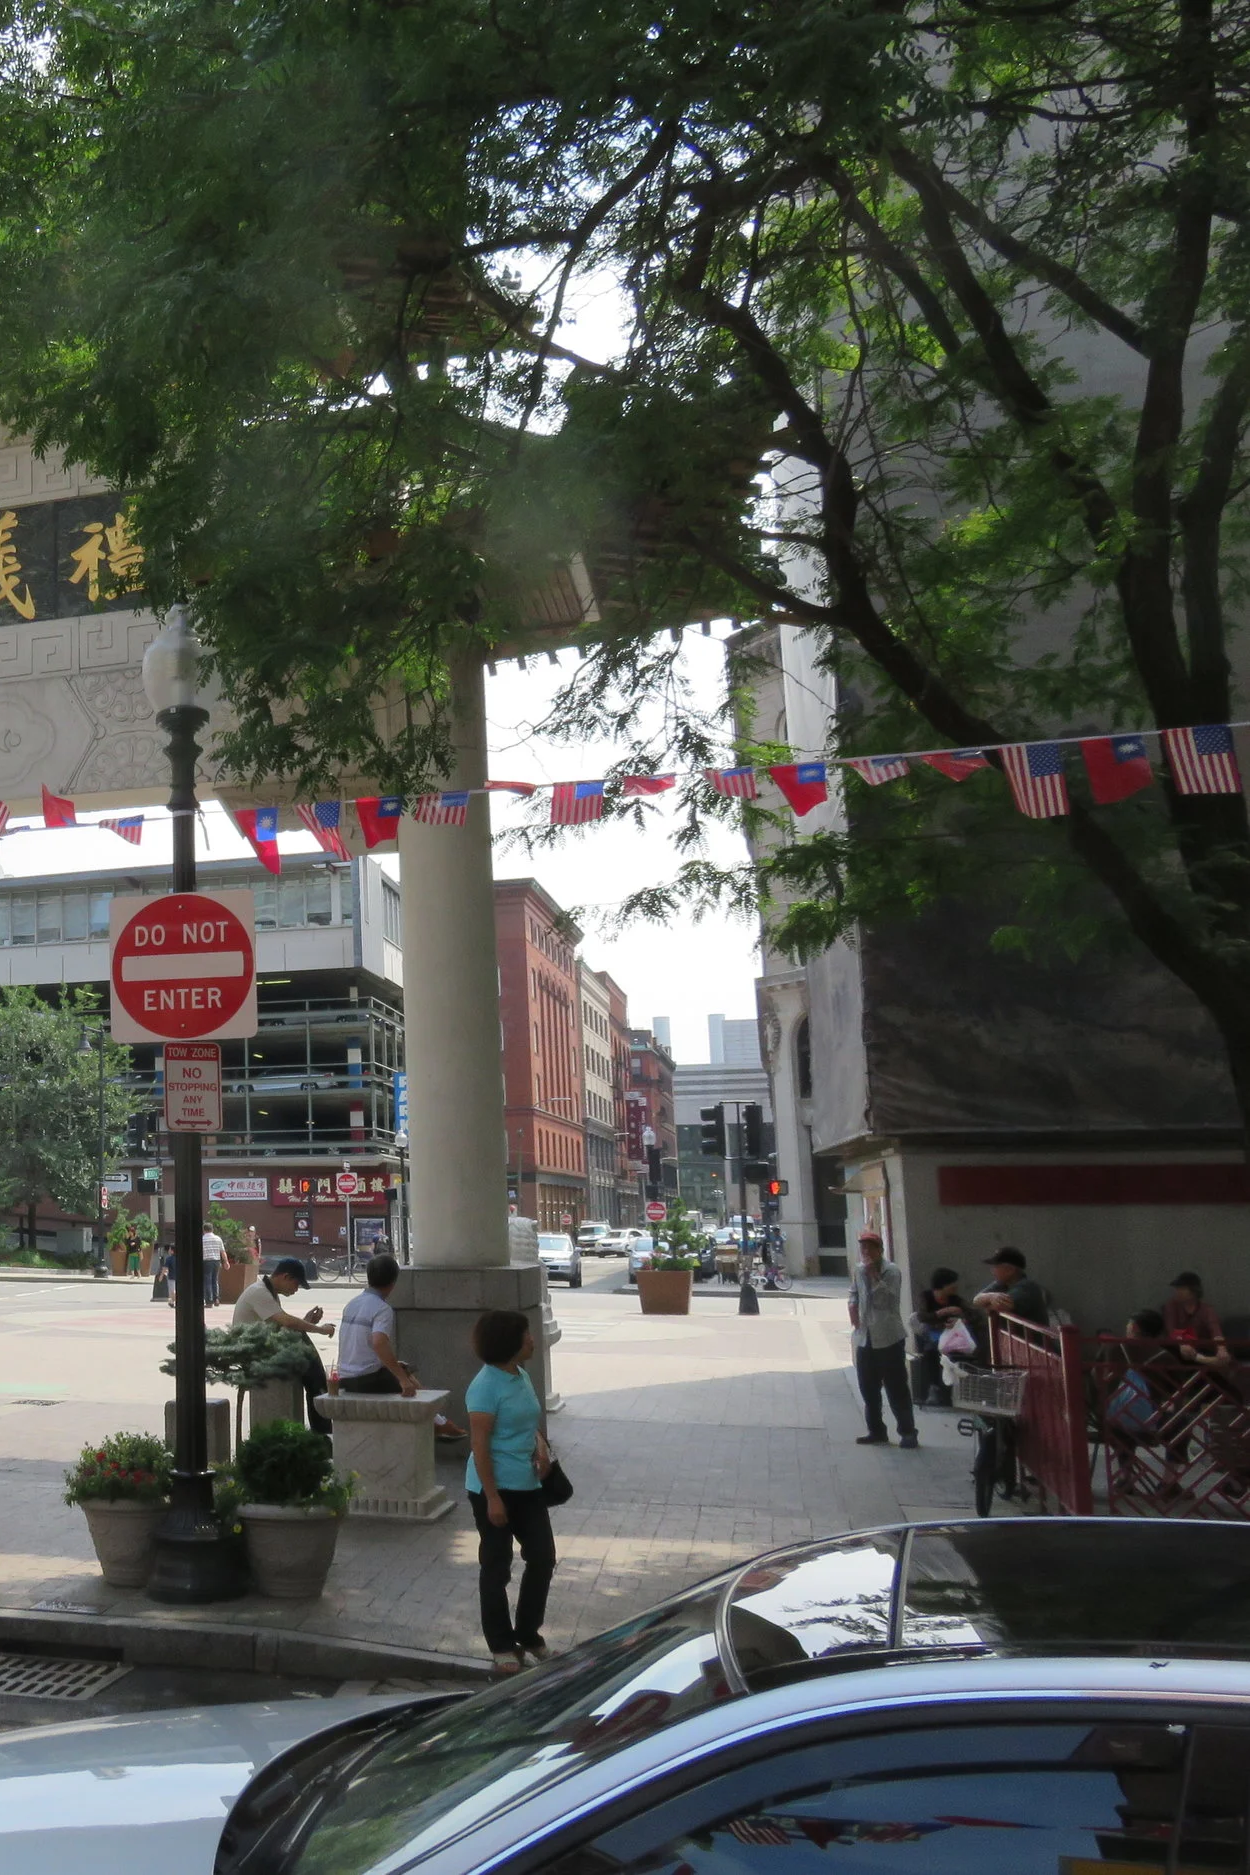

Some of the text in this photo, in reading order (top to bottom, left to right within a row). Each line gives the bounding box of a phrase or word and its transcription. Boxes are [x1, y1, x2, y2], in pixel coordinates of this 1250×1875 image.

[134, 921, 228, 947] DO NOT
[144, 987, 222, 1011] ENTER
[167, 1047, 217, 1058] TOW ZONE
[182, 1067, 202, 1079] NO
[168, 1082, 217, 1092] STOPPING
[183, 1095, 203, 1104] ANY
[182, 1107, 205, 1117] TIME
